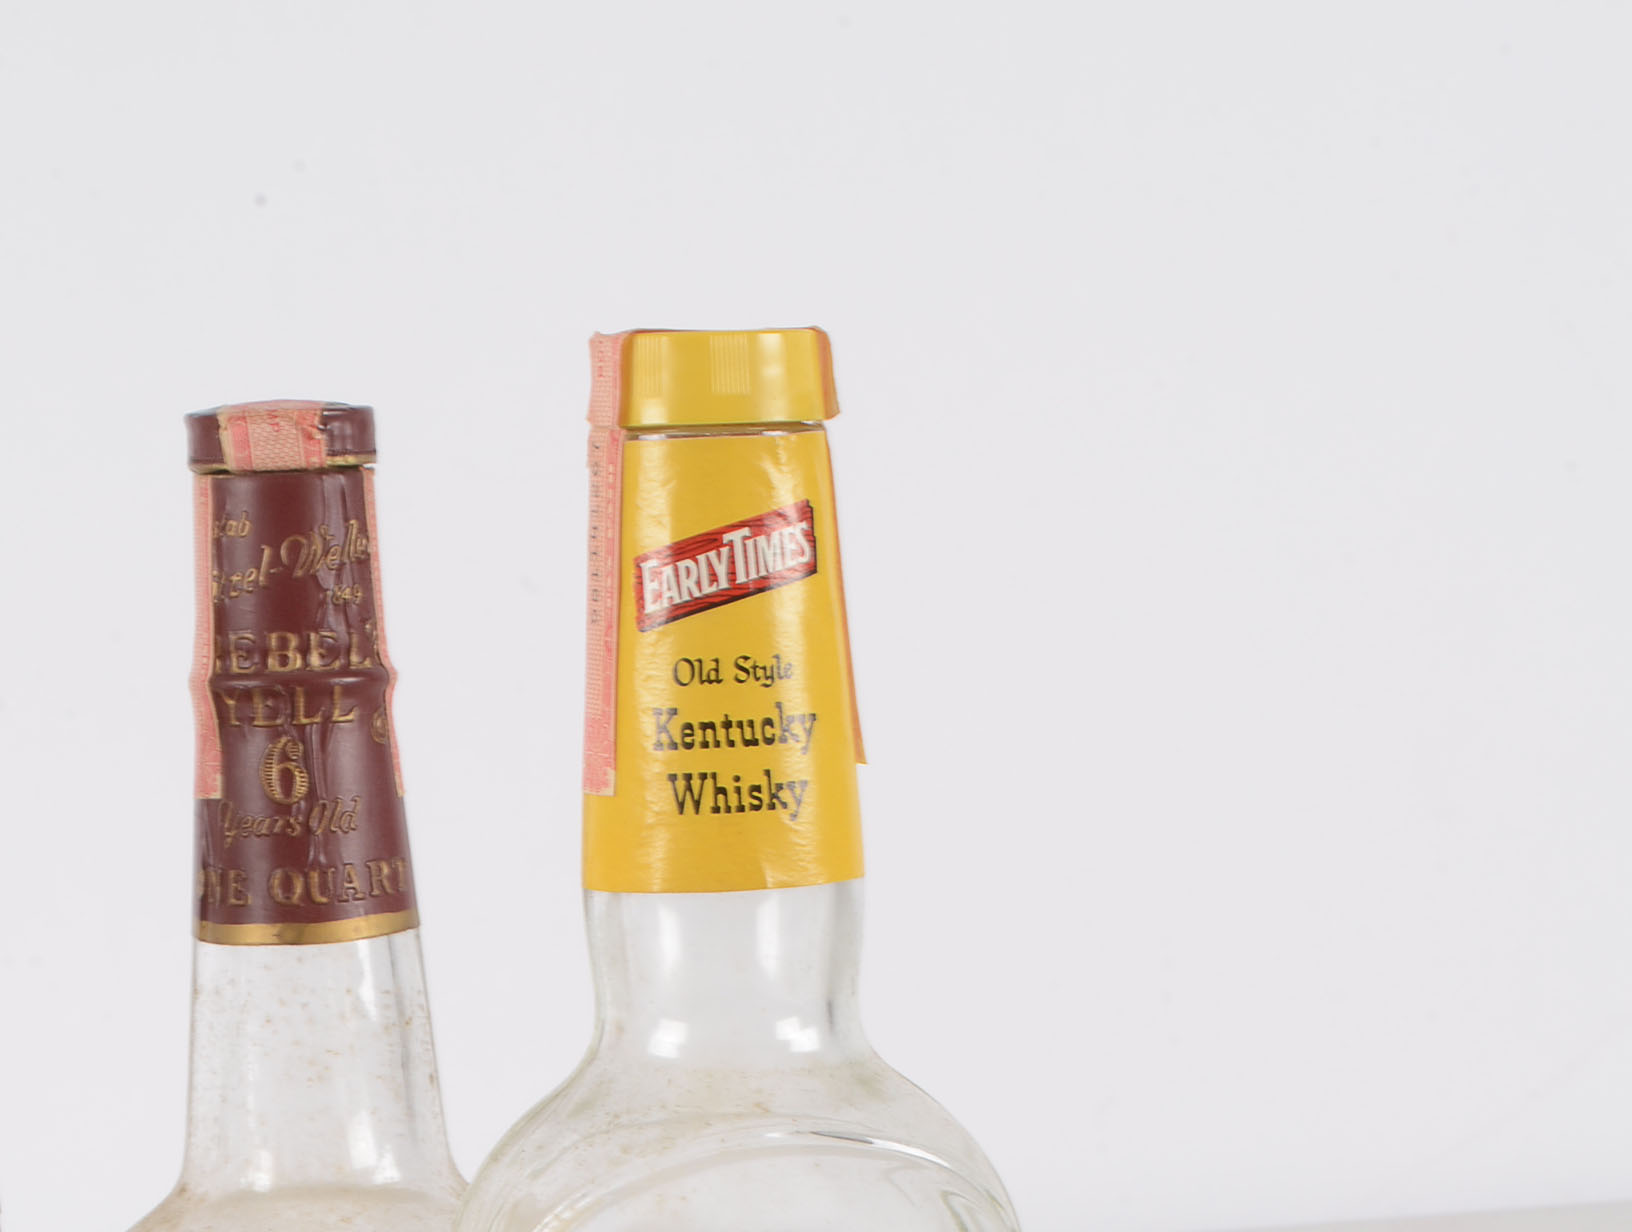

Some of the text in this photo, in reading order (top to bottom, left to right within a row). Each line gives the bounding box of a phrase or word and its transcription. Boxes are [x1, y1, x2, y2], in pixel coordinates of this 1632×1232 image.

[640, 520, 811, 613] EARLY TIMES
[673, 653, 793, 688] Old Style
[218, 684, 358, 727] YELL
[653, 701, 816, 755] Kentucky
[262, 736, 309, 804] 6
[667, 768, 808, 821] Whisky
